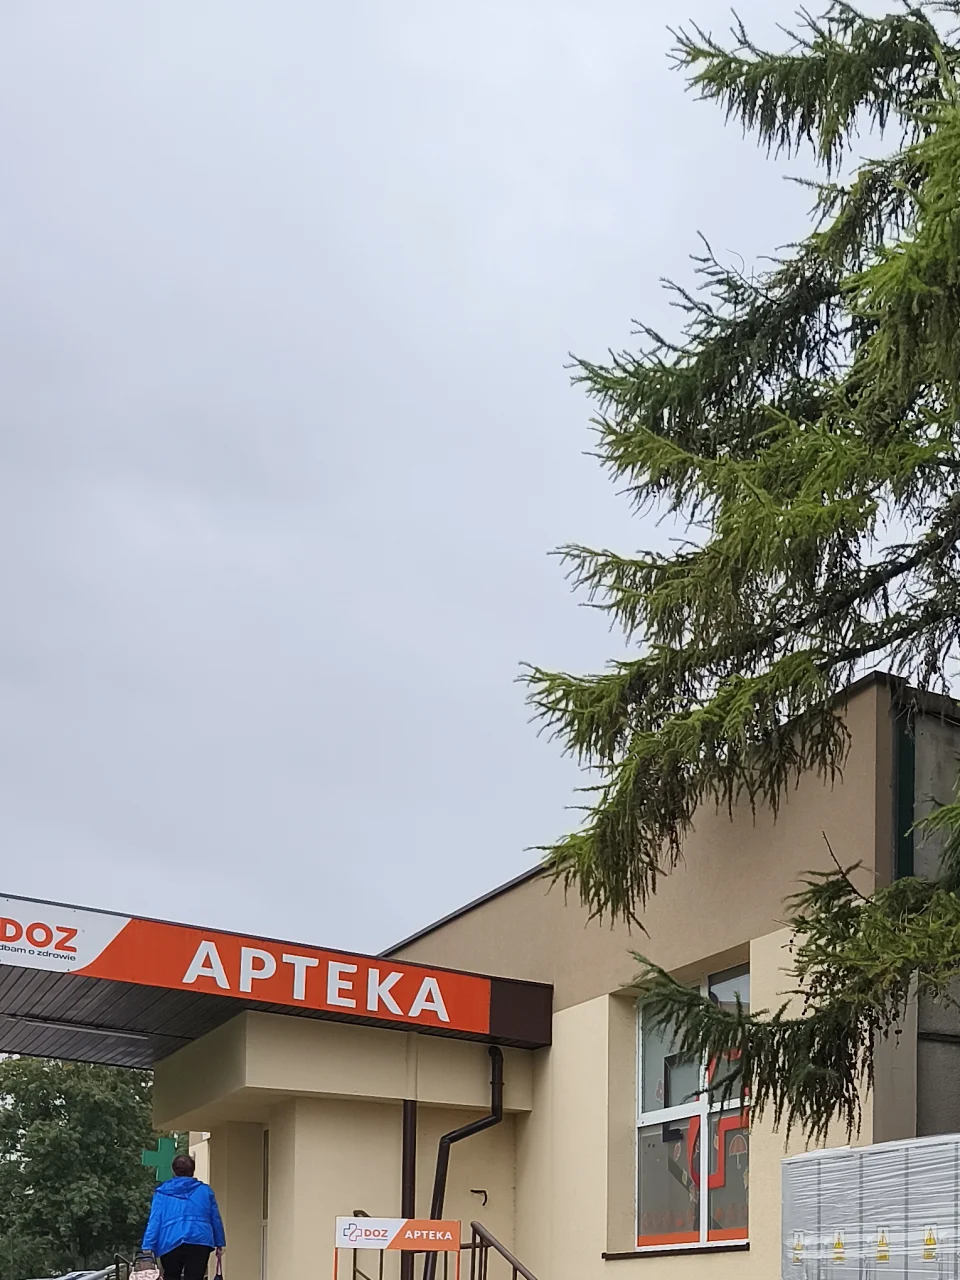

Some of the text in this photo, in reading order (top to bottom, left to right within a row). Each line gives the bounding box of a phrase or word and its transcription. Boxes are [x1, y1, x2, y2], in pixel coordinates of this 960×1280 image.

[0, 917, 78, 953] DOZ
[37, 950, 76, 961] zdrowie
[182, 940, 450, 1022] APTEKA
[364, 1229, 388, 1237] DOZ
[405, 1230, 452, 1240] APTEKA
